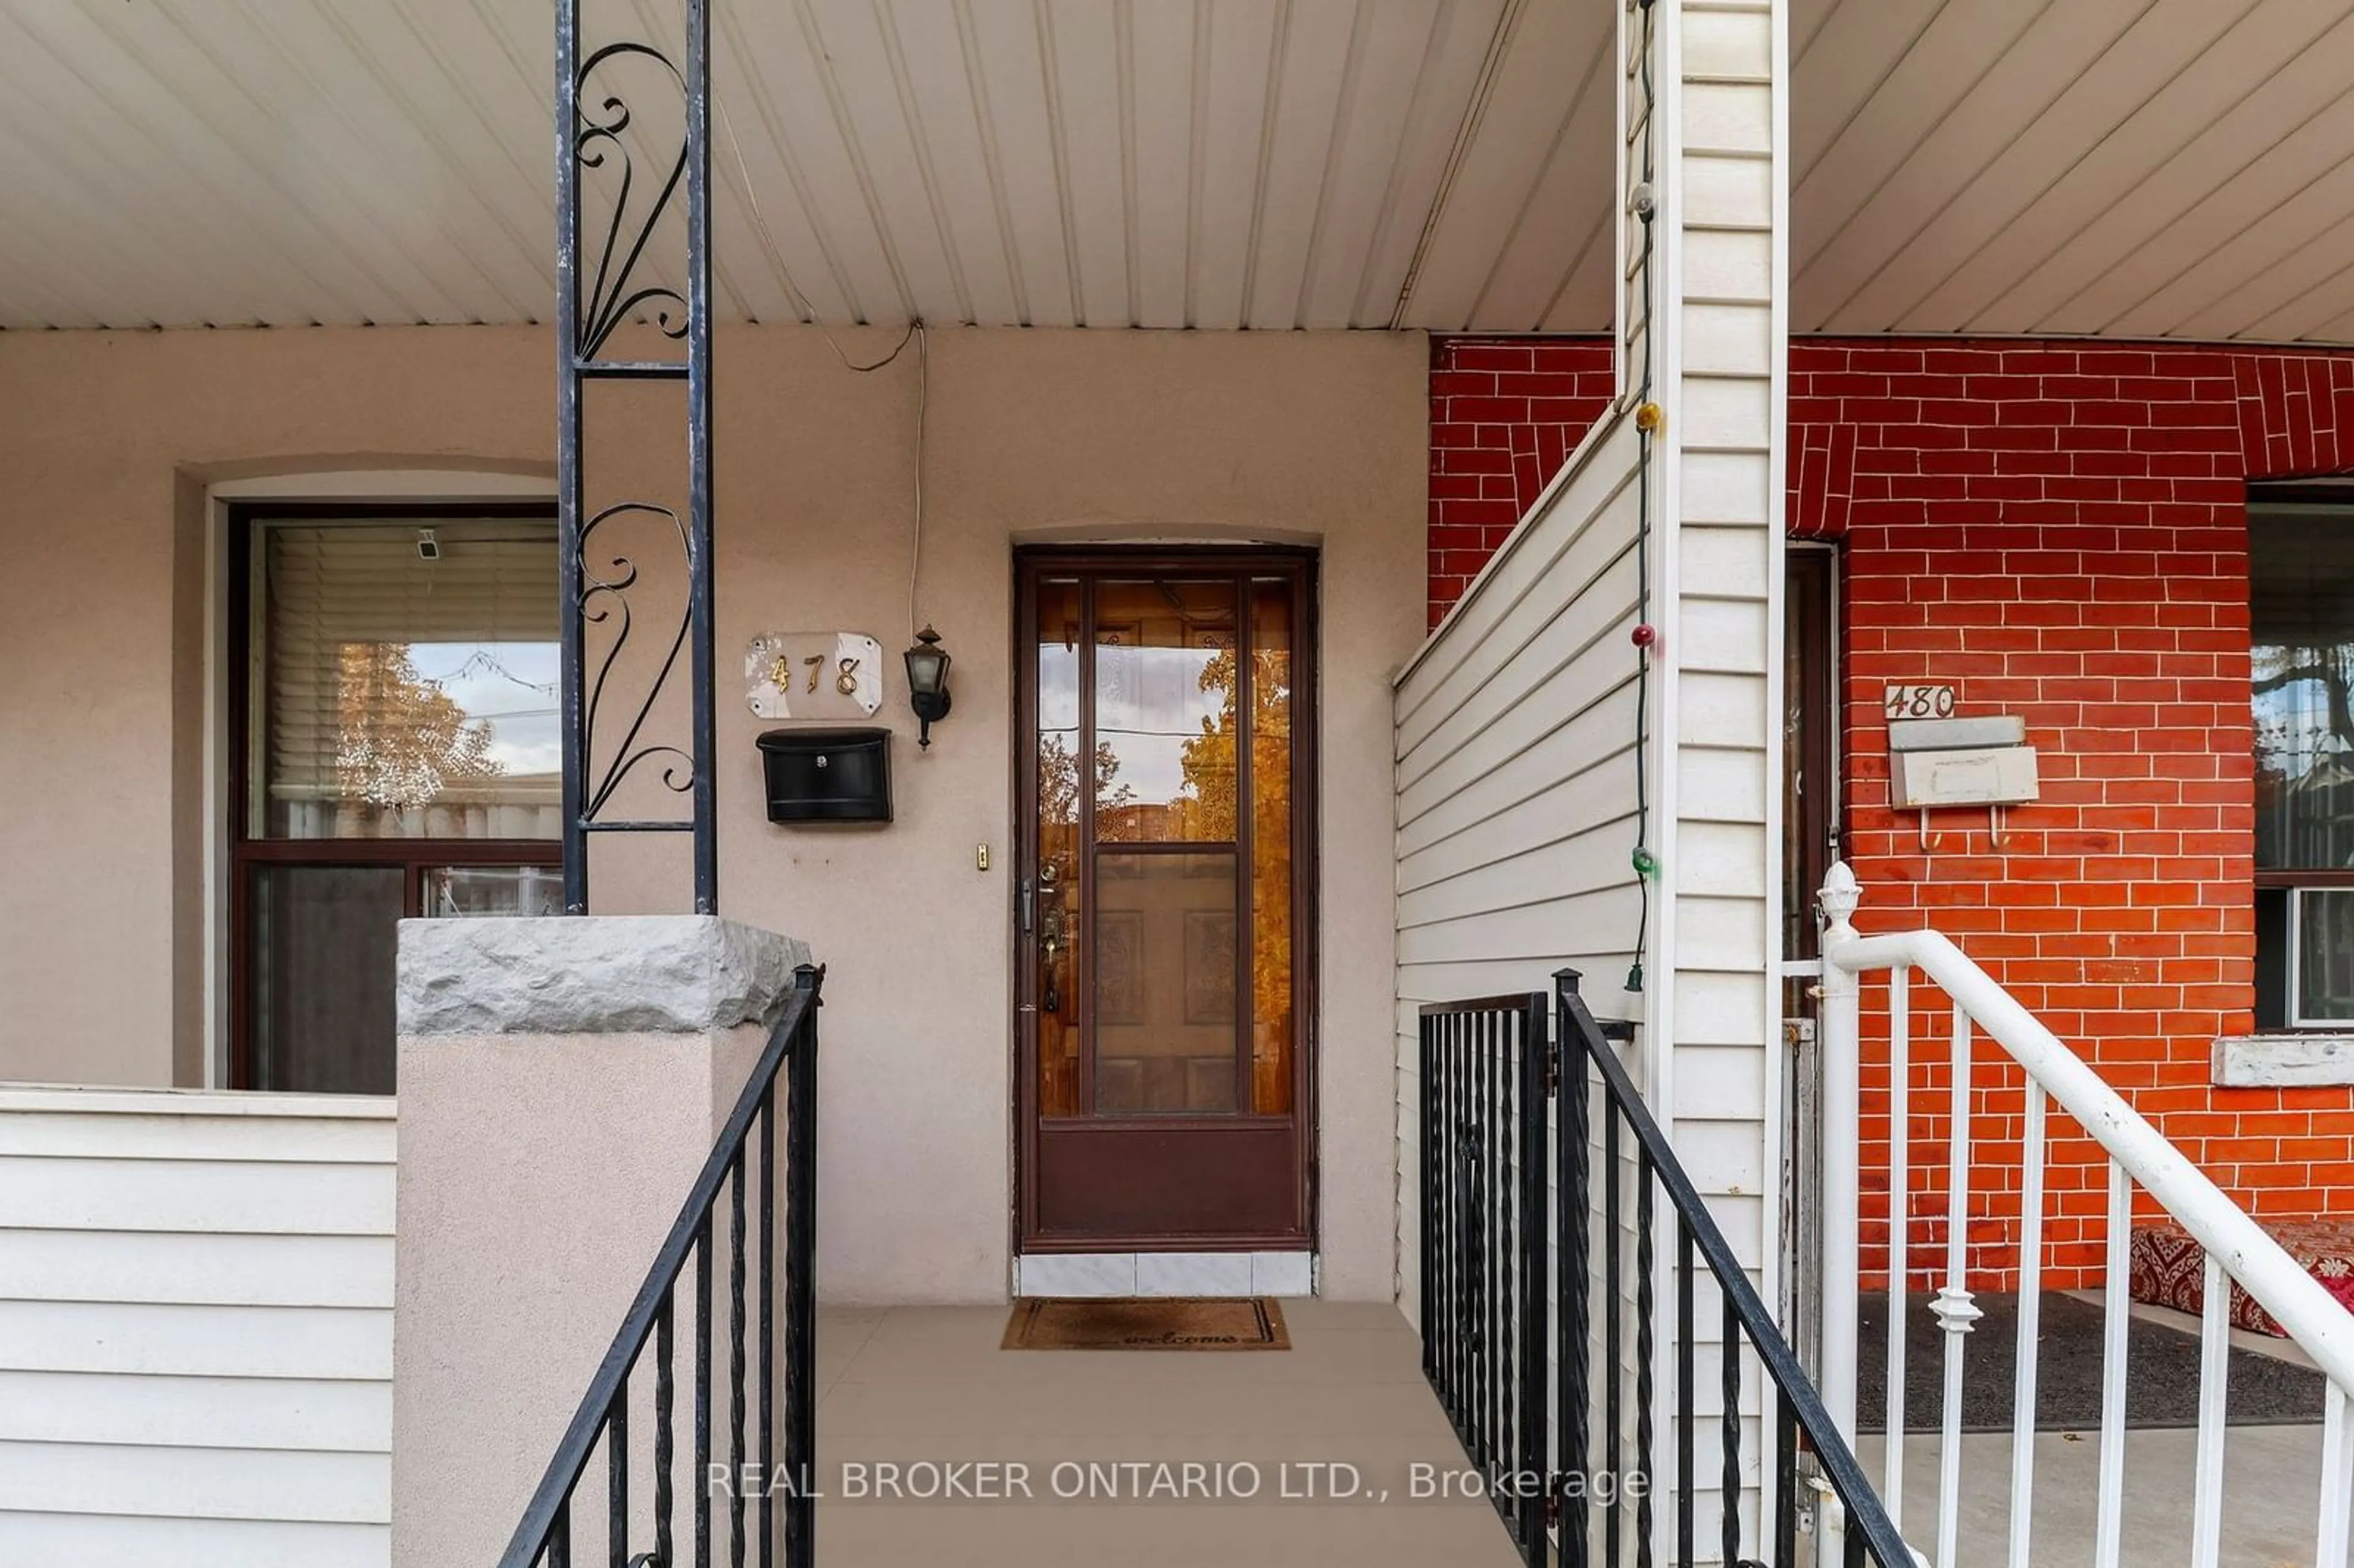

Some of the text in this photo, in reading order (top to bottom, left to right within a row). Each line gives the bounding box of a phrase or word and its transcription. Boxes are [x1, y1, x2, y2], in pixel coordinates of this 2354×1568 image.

[771, 654, 860, 695] 478
[1886, 685, 1955, 718] 480
[1124, 1331, 1238, 1344] welcome
